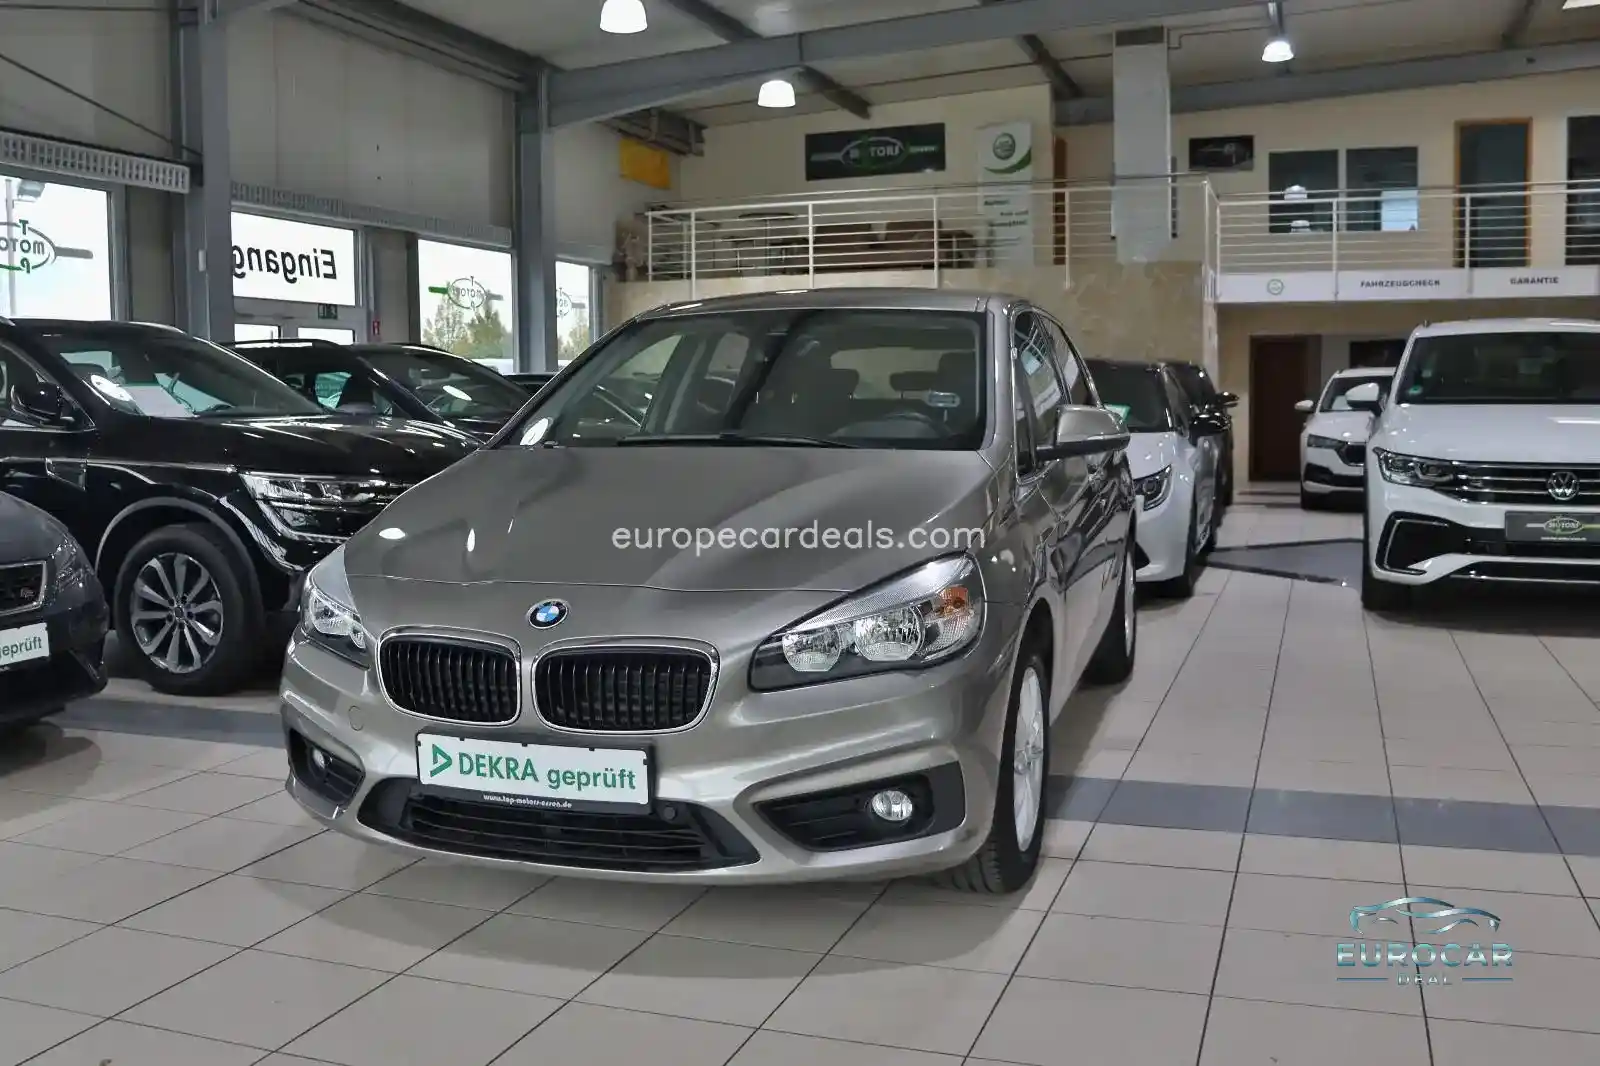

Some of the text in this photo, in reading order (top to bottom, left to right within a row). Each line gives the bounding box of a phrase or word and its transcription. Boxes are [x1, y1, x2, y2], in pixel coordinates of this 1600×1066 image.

[1360, 279, 1441, 289] FAHRZEUGCHECK
[1509, 276, 1560, 286] GARANTIE
[458, 751, 637, 791] DEKRA geprüft
